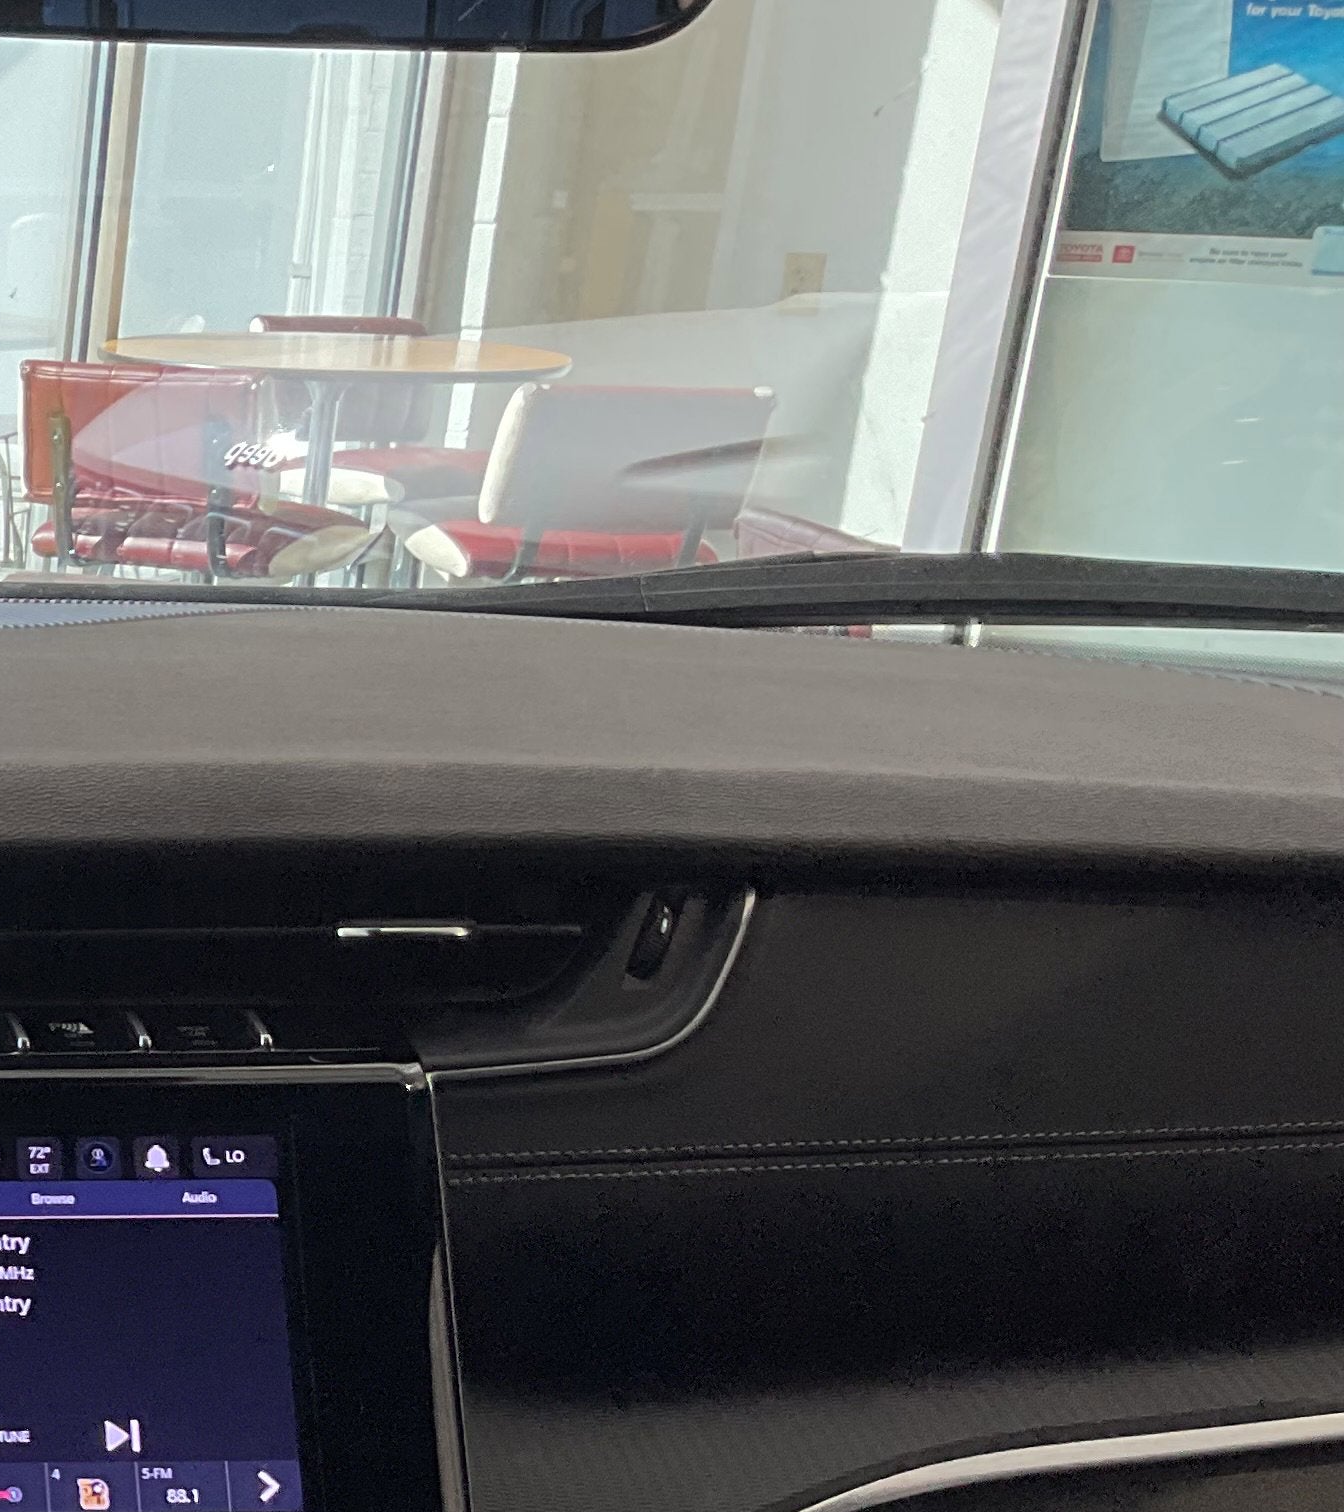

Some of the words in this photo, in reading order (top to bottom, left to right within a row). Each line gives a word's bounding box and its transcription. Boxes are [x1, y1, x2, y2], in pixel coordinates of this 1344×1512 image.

[224, 1150, 246, 1164] LO
[30, 1192, 76, 1206] Browse
[181, 1191, 218, 1204] Audio
[50, 1468, 60, 1480] 4
[141, 1467, 173, 1480] 5-FM
[165, 1488, 200, 1504] 88.1
